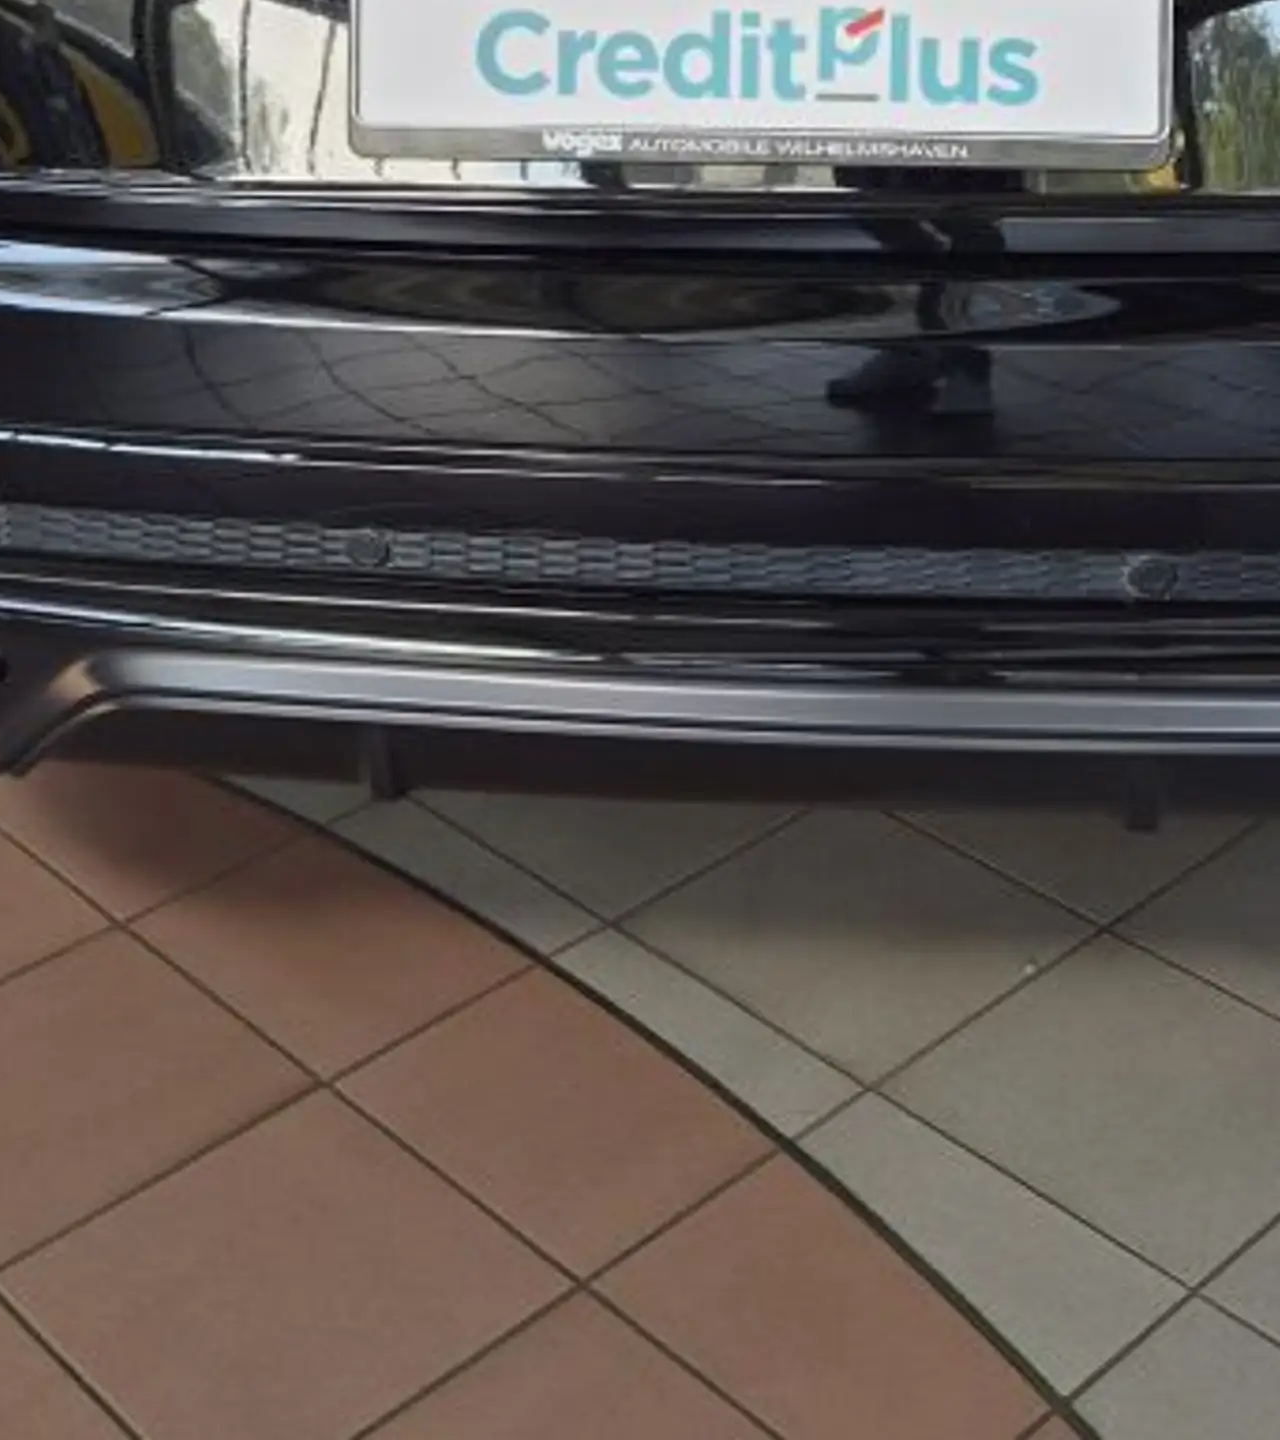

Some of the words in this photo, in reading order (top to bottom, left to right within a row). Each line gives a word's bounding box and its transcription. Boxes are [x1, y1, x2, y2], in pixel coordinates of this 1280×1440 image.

[476, 5, 1040, 106] CreditPlus
[629, 136, 770, 155] AUTOMOBILE
[774, 137, 969, 158] WILHELMSHAVEN
